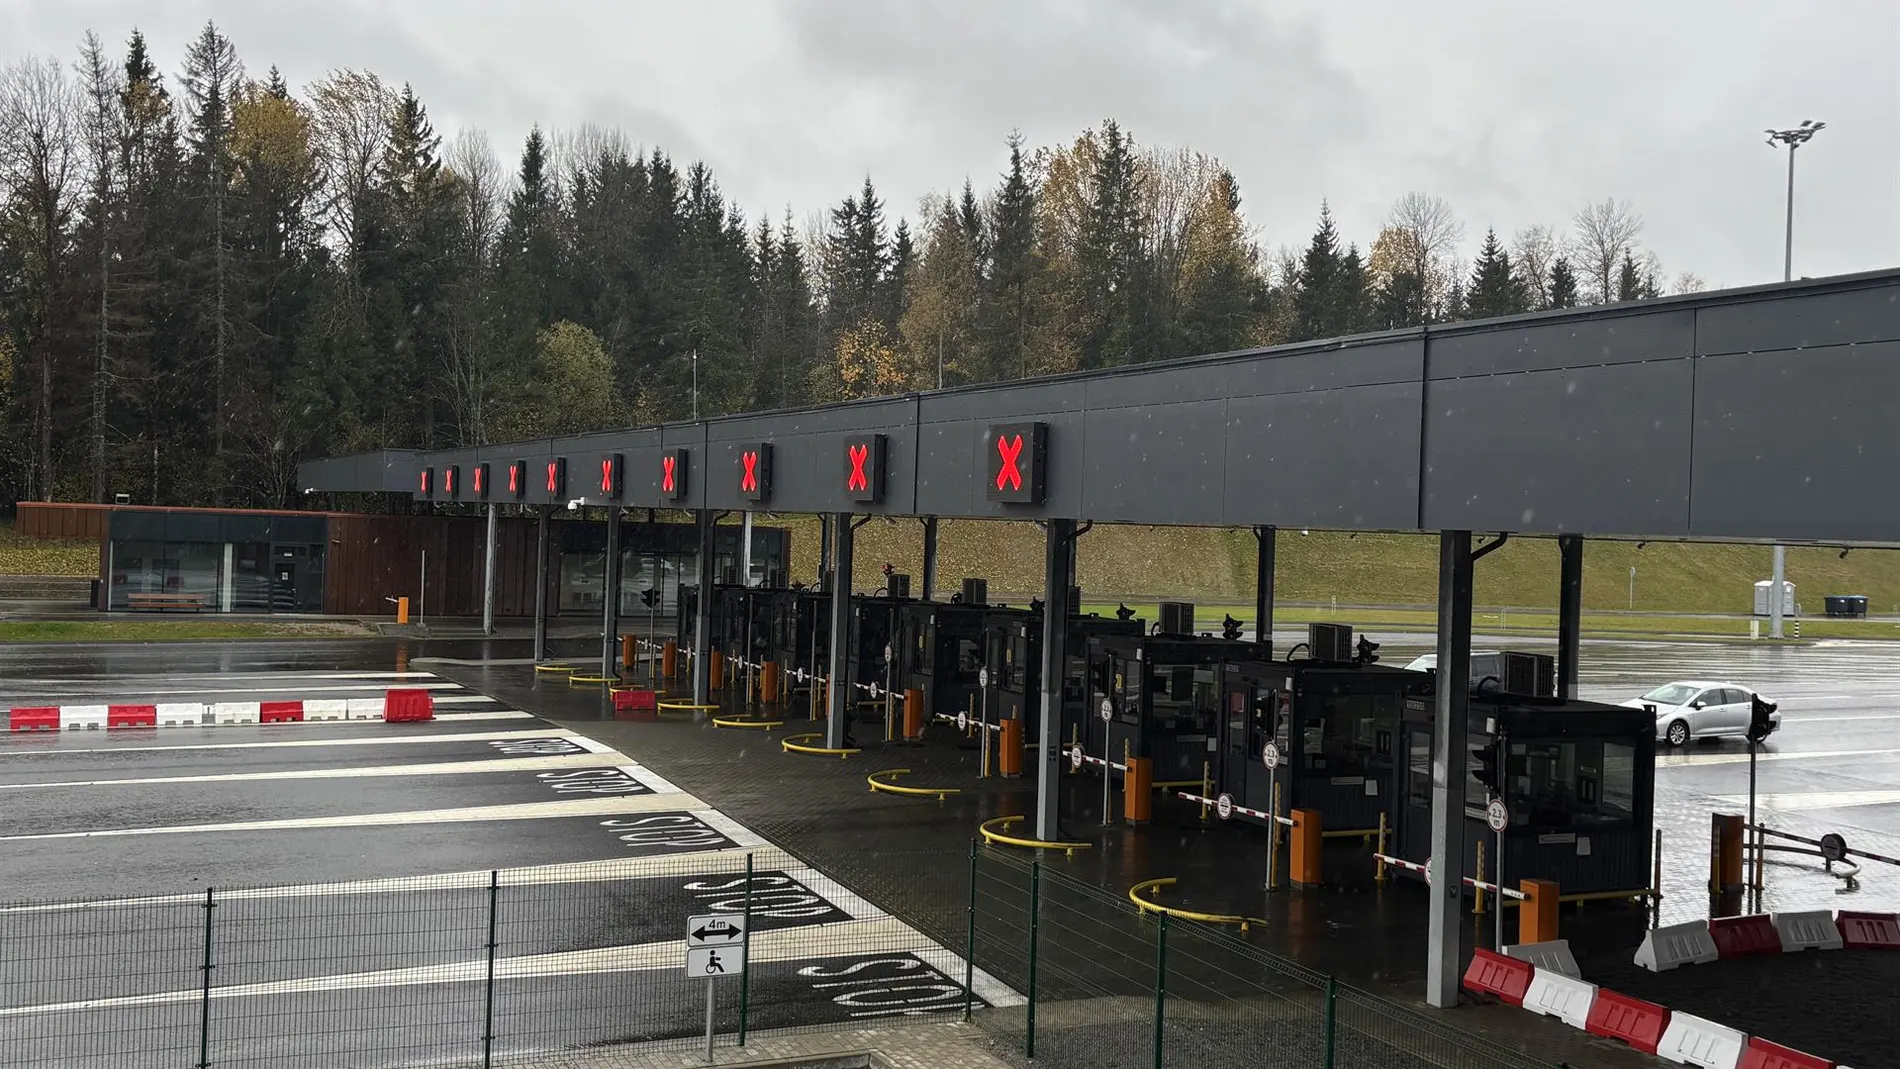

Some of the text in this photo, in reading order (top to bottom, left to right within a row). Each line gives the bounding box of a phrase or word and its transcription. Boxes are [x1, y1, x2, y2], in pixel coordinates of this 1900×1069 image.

[536, 769, 645, 794] STOP
[1492, 808, 1502, 819] 2.3
[599, 815, 726, 847] STOP
[683, 876, 834, 918] STOP
[708, 919, 726, 929] 4m
[796, 958, 985, 1017] STOP
